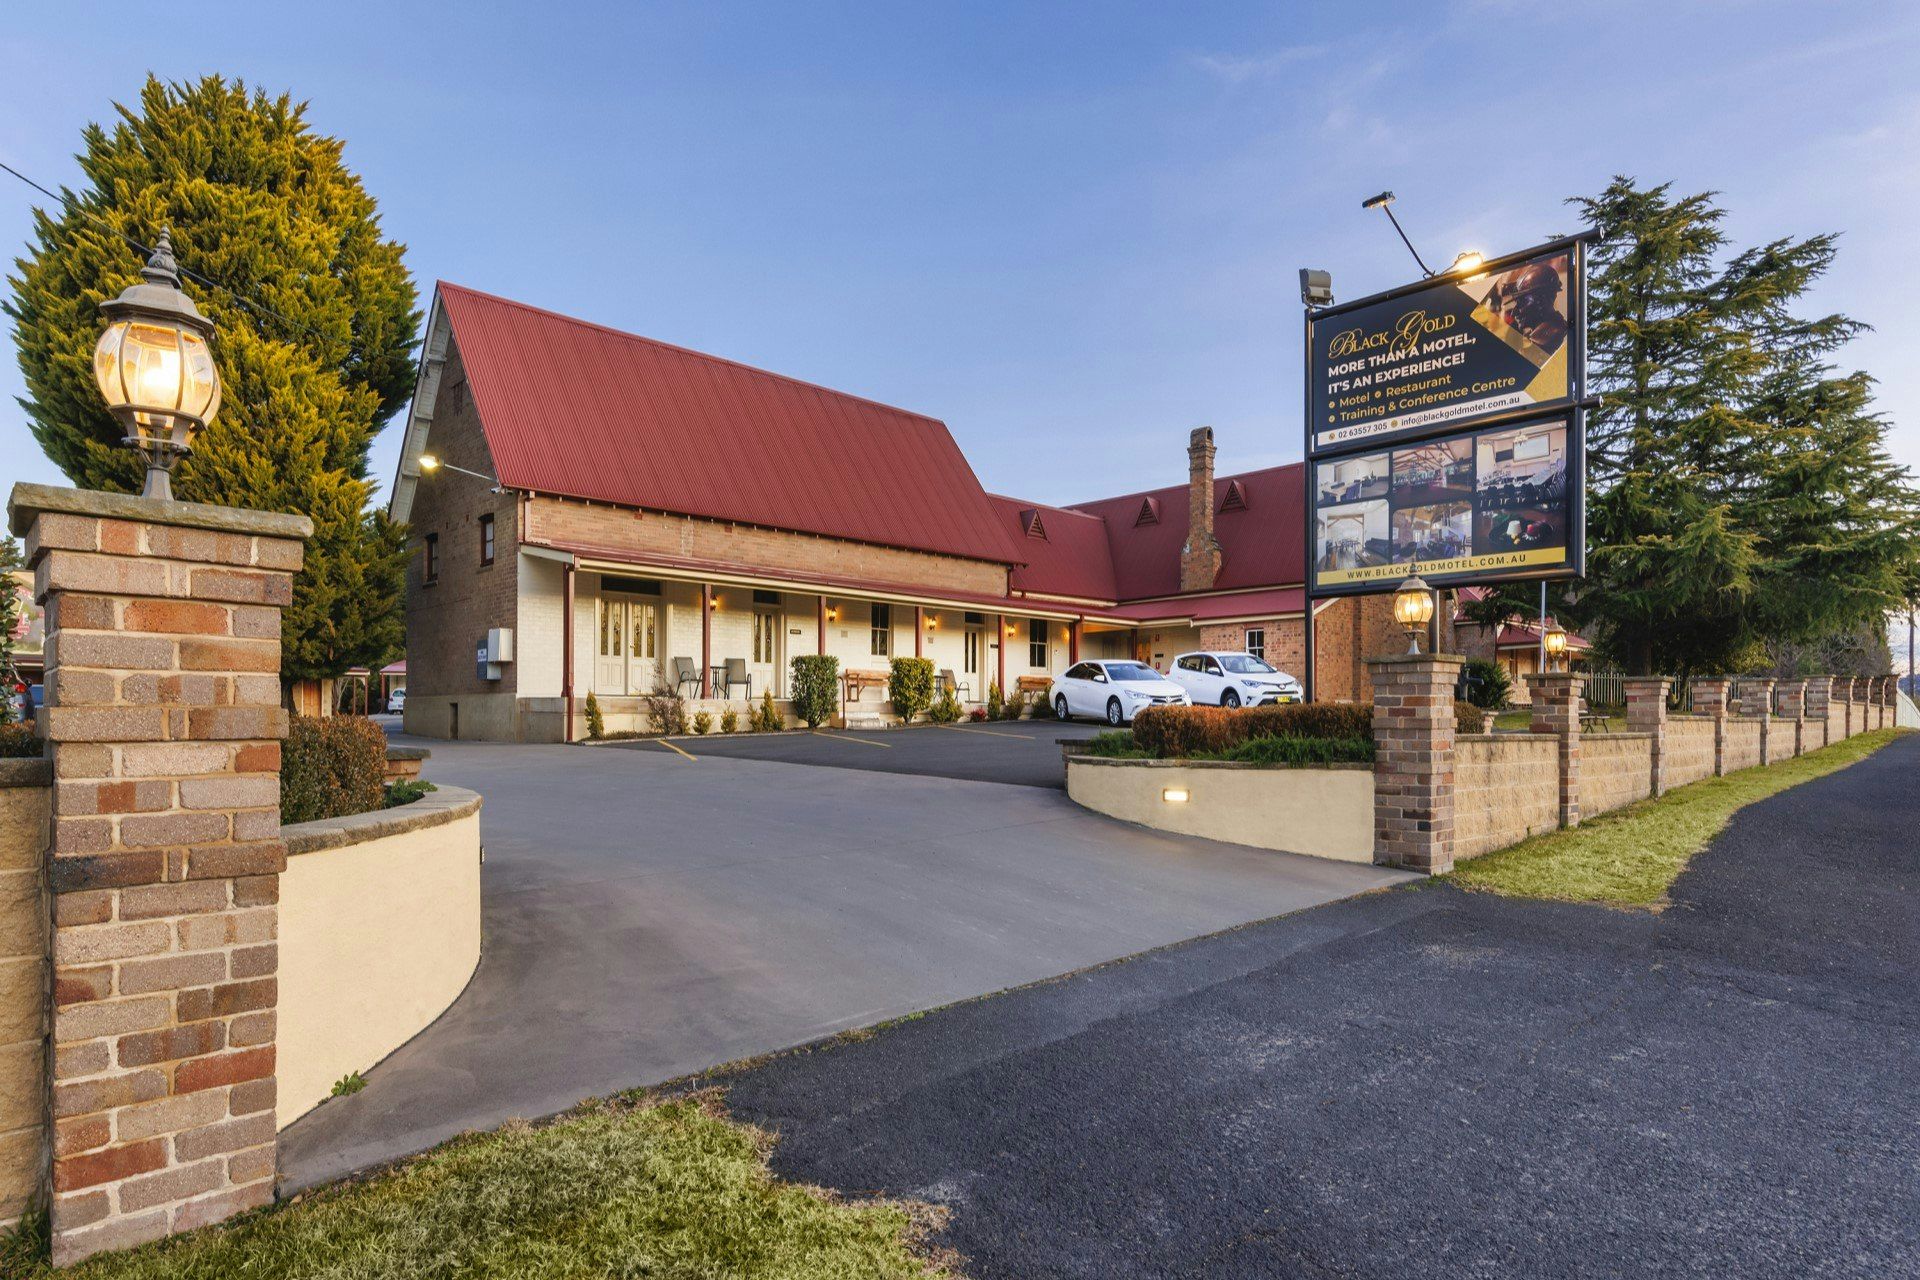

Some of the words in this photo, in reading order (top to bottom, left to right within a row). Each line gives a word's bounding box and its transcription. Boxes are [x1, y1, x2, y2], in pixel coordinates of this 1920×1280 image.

[1328, 359, 1366, 378] MORE
[1368, 349, 1407, 368] THAN
[1409, 346, 1420, 358] A
[1423, 332, 1477, 355] MOTEL,
[1328, 380, 1350, 395] IT'S
[1352, 374, 1372, 389] AN
[1375, 352, 1466, 384] EXPERIENCE!
[1340, 392, 1370, 408] Motel
[1386, 374, 1452, 398] Restaurant
[1340, 405, 1386, 422] Training
[1388, 401, 1396, 412] &
[1399, 386, 1469, 409] Conference
[1472, 376, 1516, 395] Centre
[1338, 430, 1347, 439] 02
[1349, 426, 1372, 437] 63557
[1374, 422, 1388, 432] 305
[1401, 396, 1521, 427] info@blackgoldmotel.com.au
[1347, 554, 1526, 579] WWW.BLACKOLDMOTEL.COM.AU
